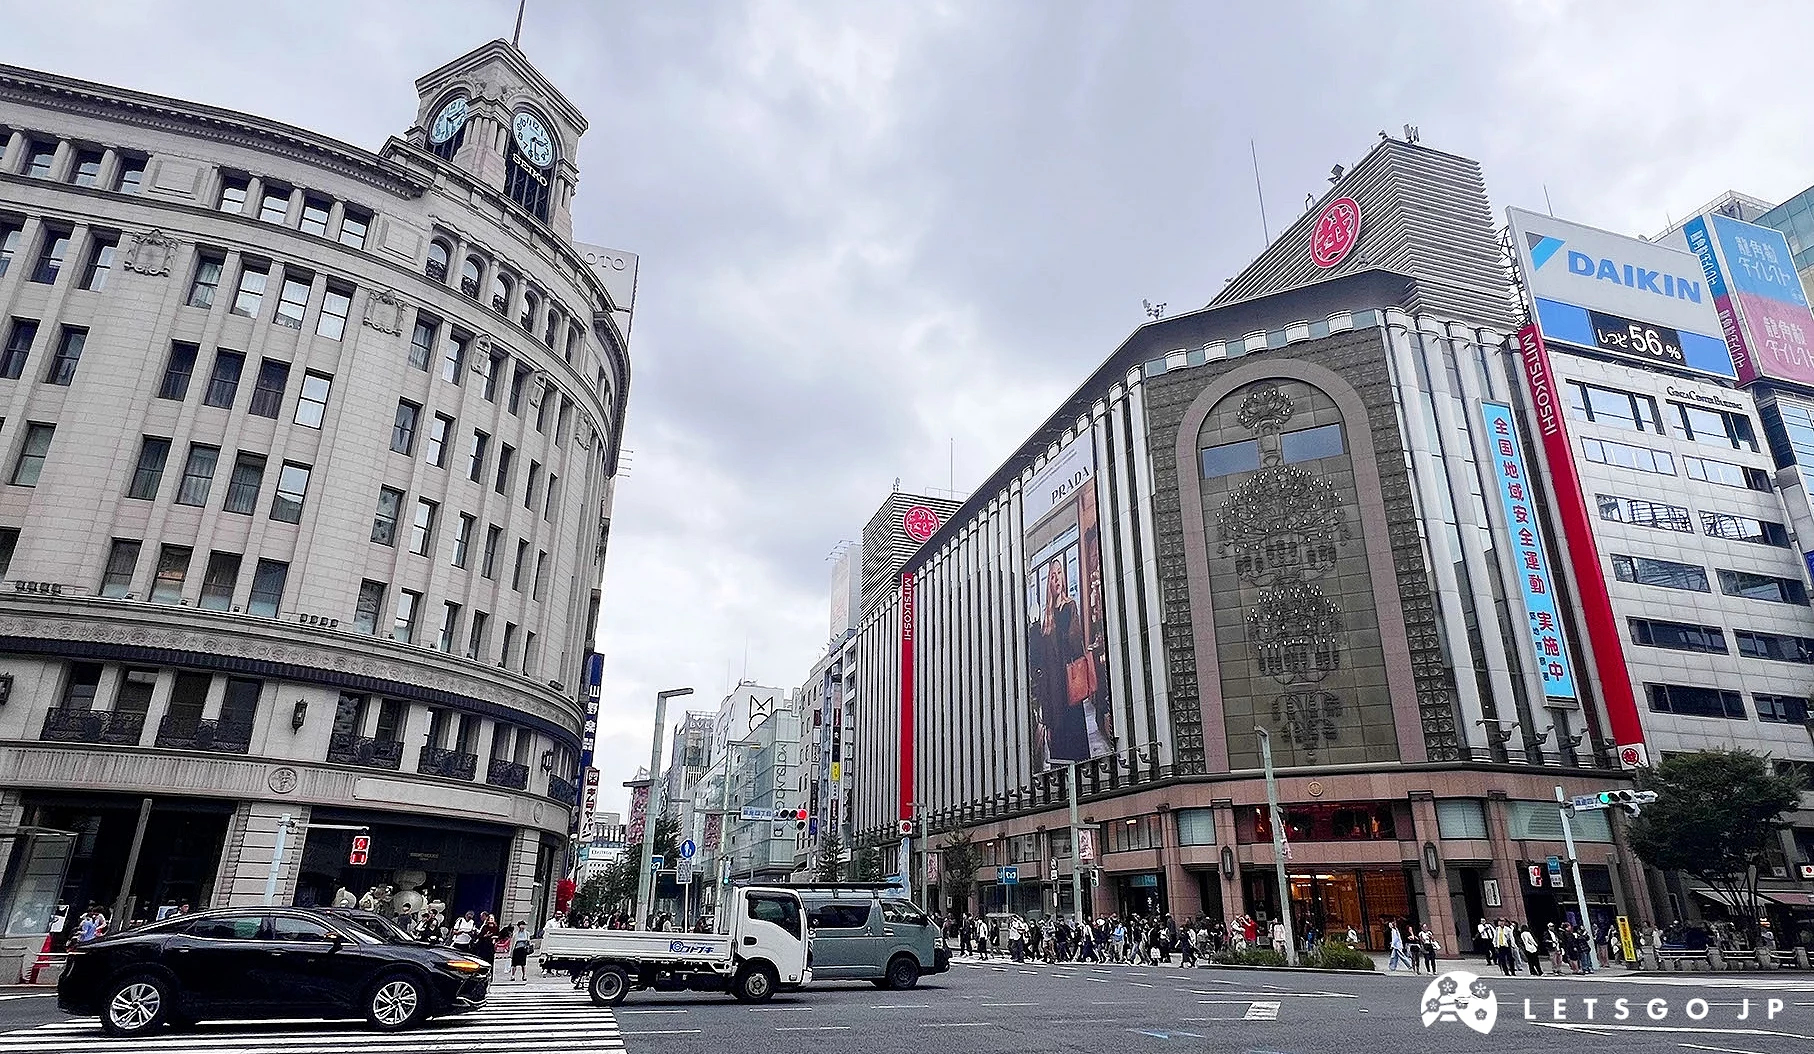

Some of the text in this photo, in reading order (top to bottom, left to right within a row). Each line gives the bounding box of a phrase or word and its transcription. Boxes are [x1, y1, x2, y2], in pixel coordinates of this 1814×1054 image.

[513, 152, 548, 187] SEIKO
[1567, 250, 1702, 304] DAIKIN
[1521, 331, 1558, 437] MITSUKOSHI
[1051, 466, 1090, 505] PRADA
[1492, 416, 1564, 681] 全国地域安全運動 実施中
[903, 577, 912, 641] MITSUKOSHI
